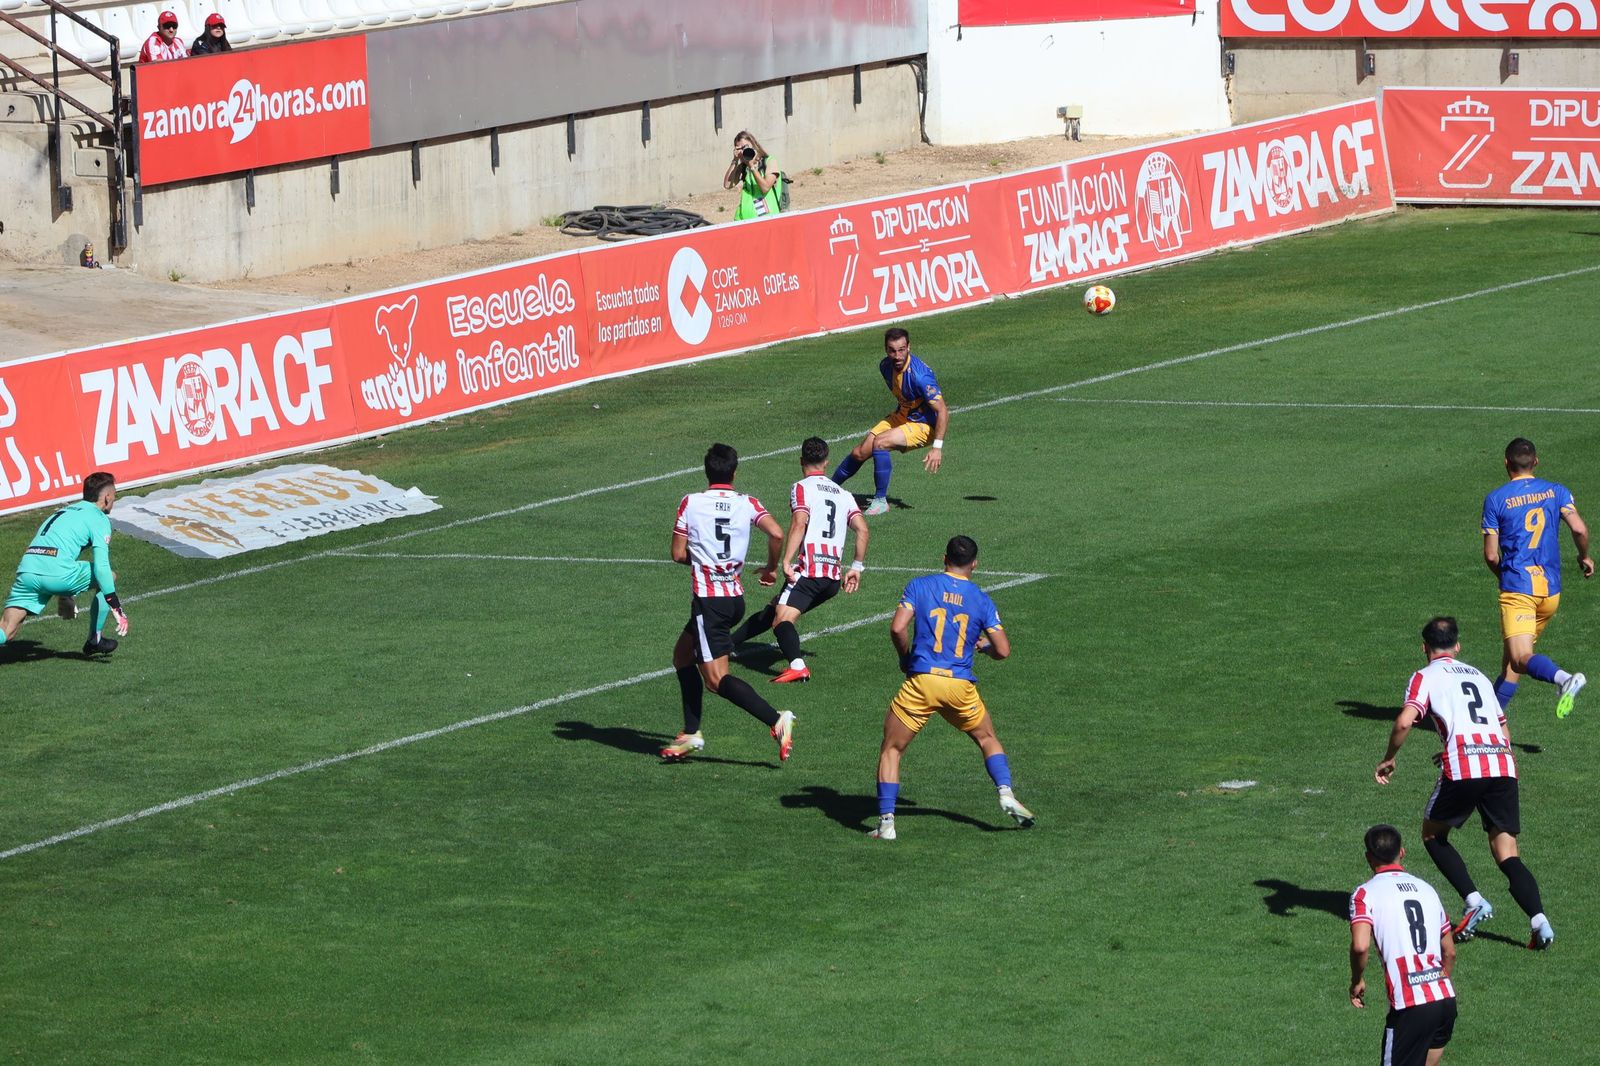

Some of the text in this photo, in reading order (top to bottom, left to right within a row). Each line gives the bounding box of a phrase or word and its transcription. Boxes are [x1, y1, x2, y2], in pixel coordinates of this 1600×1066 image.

[143, 79, 366, 140] zamora24horas.com
[1202, 119, 1375, 230] ZAMORA CF
[1017, 162, 1127, 230] FUNDACIÓN
[596, 282, 660, 311] Escucha todos
[712, 266, 739, 290] COPE
[763, 272, 800, 296] COPE.es
[872, 250, 990, 314] ZAMORA
[447, 273, 575, 337] Escuela
[714, 287, 760, 313] ZAMORA
[598, 315, 661, 345] los partidos en
[456, 325, 580, 395] infantil
[80, 342, 280, 466] ZAMORA
[273, 328, 333, 426] CF
[34, 451, 82, 492] S.L.
[40, 510, 67, 537] 1
[715, 517, 731, 559] 5
[822, 499, 837, 539] 3
[1524, 507, 1546, 549] 9
[929, 607, 970, 658] 11
[1461, 681, 1488, 725] 2
[1396, 883, 1418, 893] RUFO
[1403, 899, 1428, 954] 8
